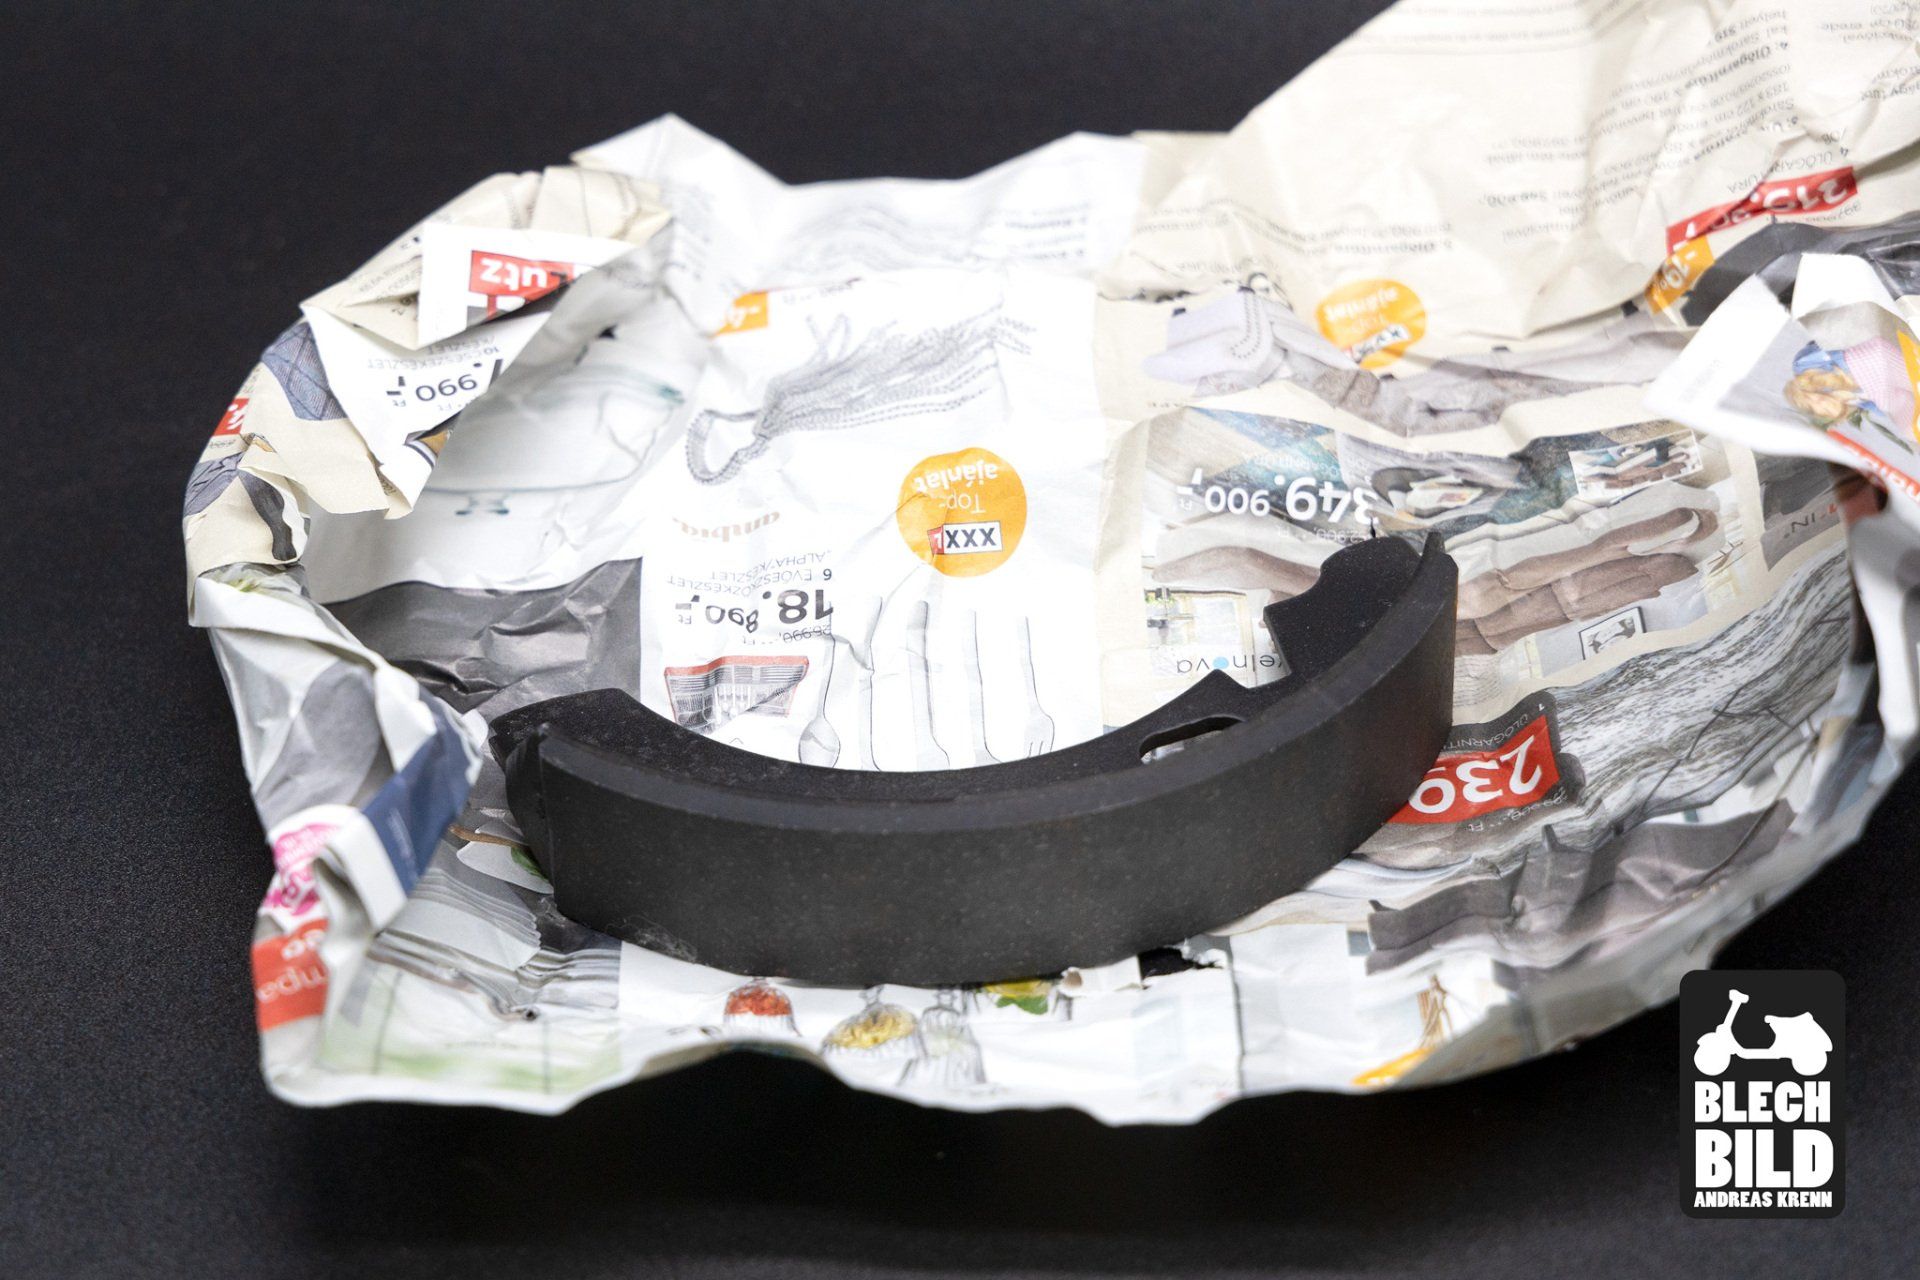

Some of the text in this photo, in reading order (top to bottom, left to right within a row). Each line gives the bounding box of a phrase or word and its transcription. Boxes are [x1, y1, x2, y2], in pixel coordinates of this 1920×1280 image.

[913, 459, 999, 494] ajánlat
[938, 488, 986, 515] Top-
[823, 569, 833, 581] 6
